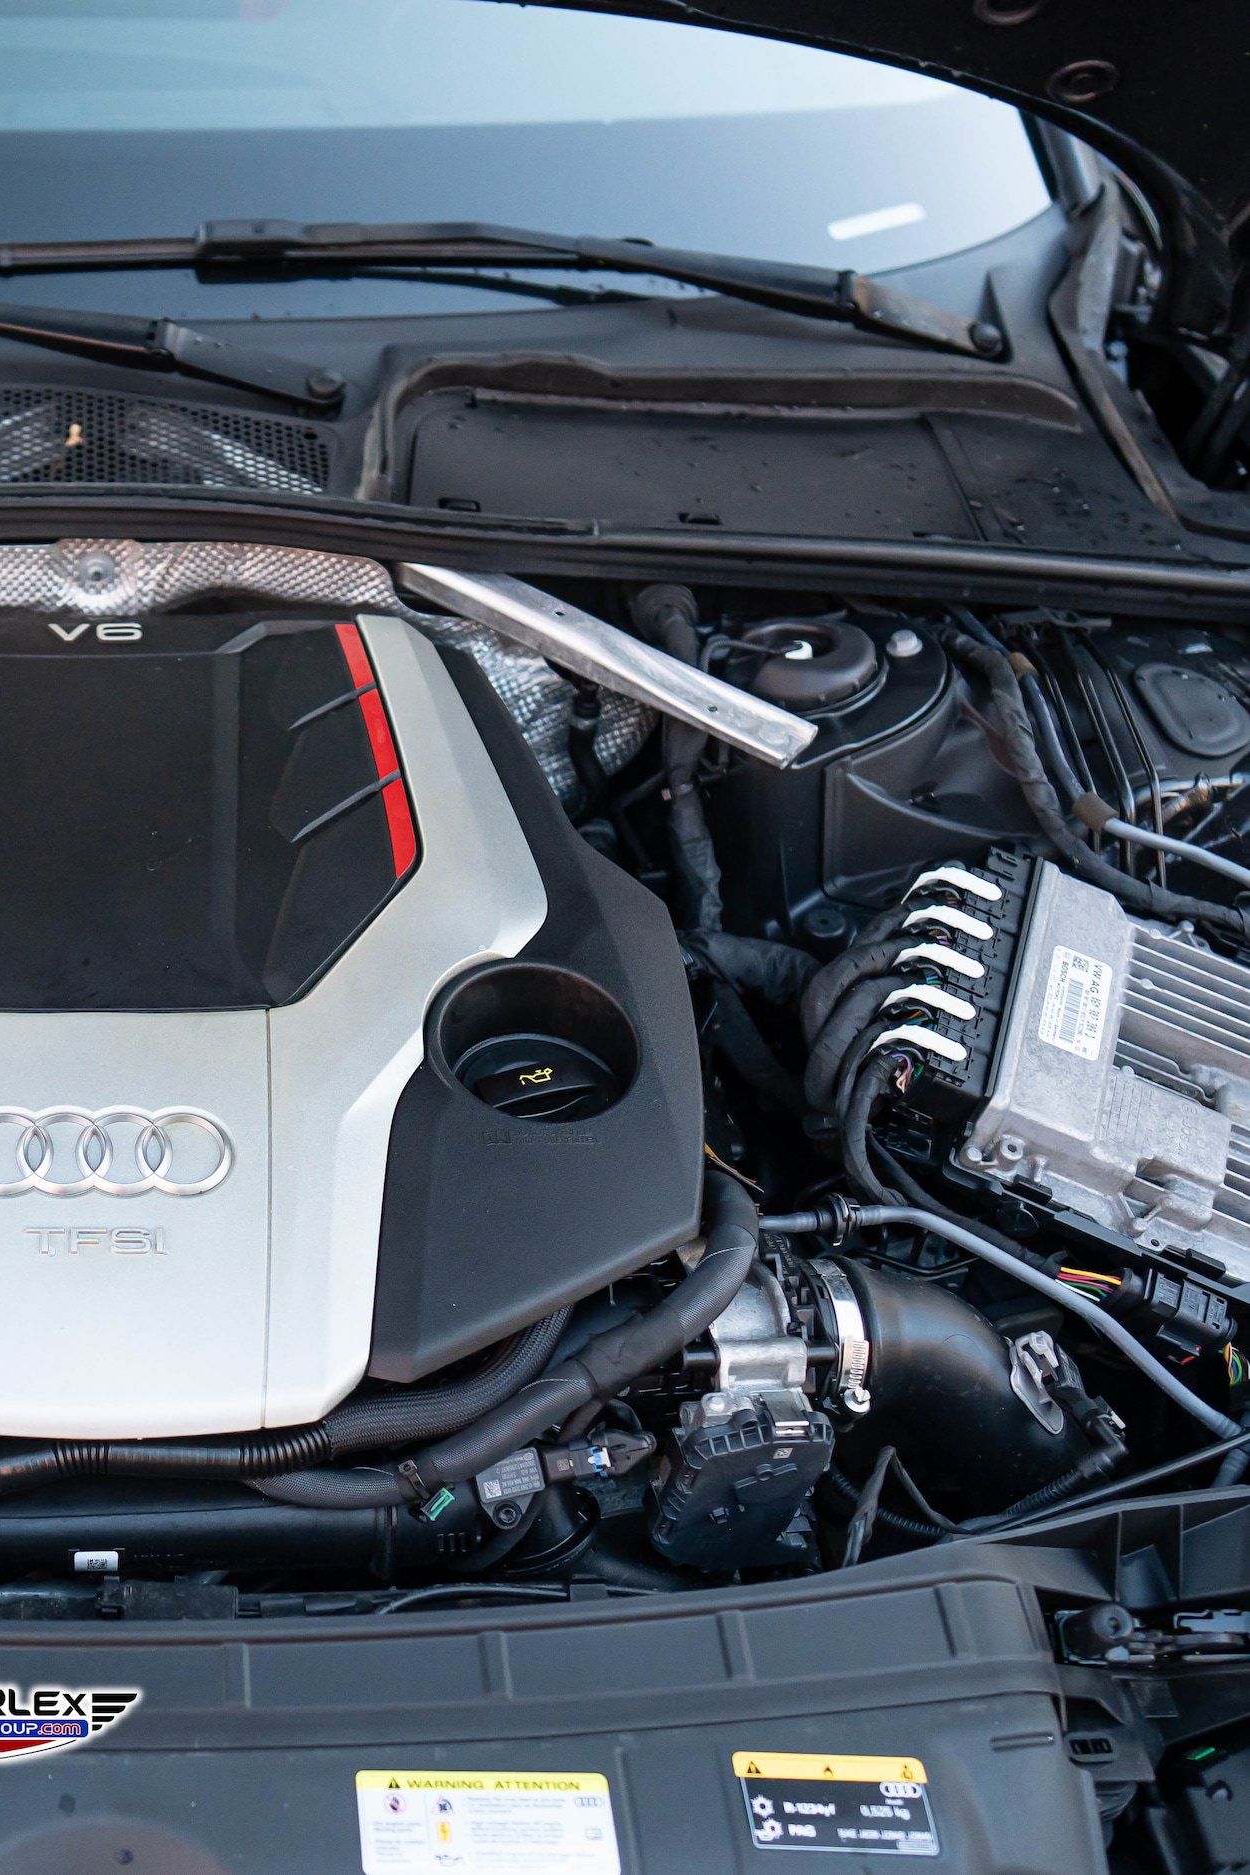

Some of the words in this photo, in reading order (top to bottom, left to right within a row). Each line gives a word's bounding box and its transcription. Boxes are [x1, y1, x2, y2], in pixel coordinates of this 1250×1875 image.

[48, 623, 143, 641] V6
[22, 1227, 168, 1255] TFSI
[407, 1779, 484, 1789] WARNING
[494, 1780, 580, 1791] ATTENTION
